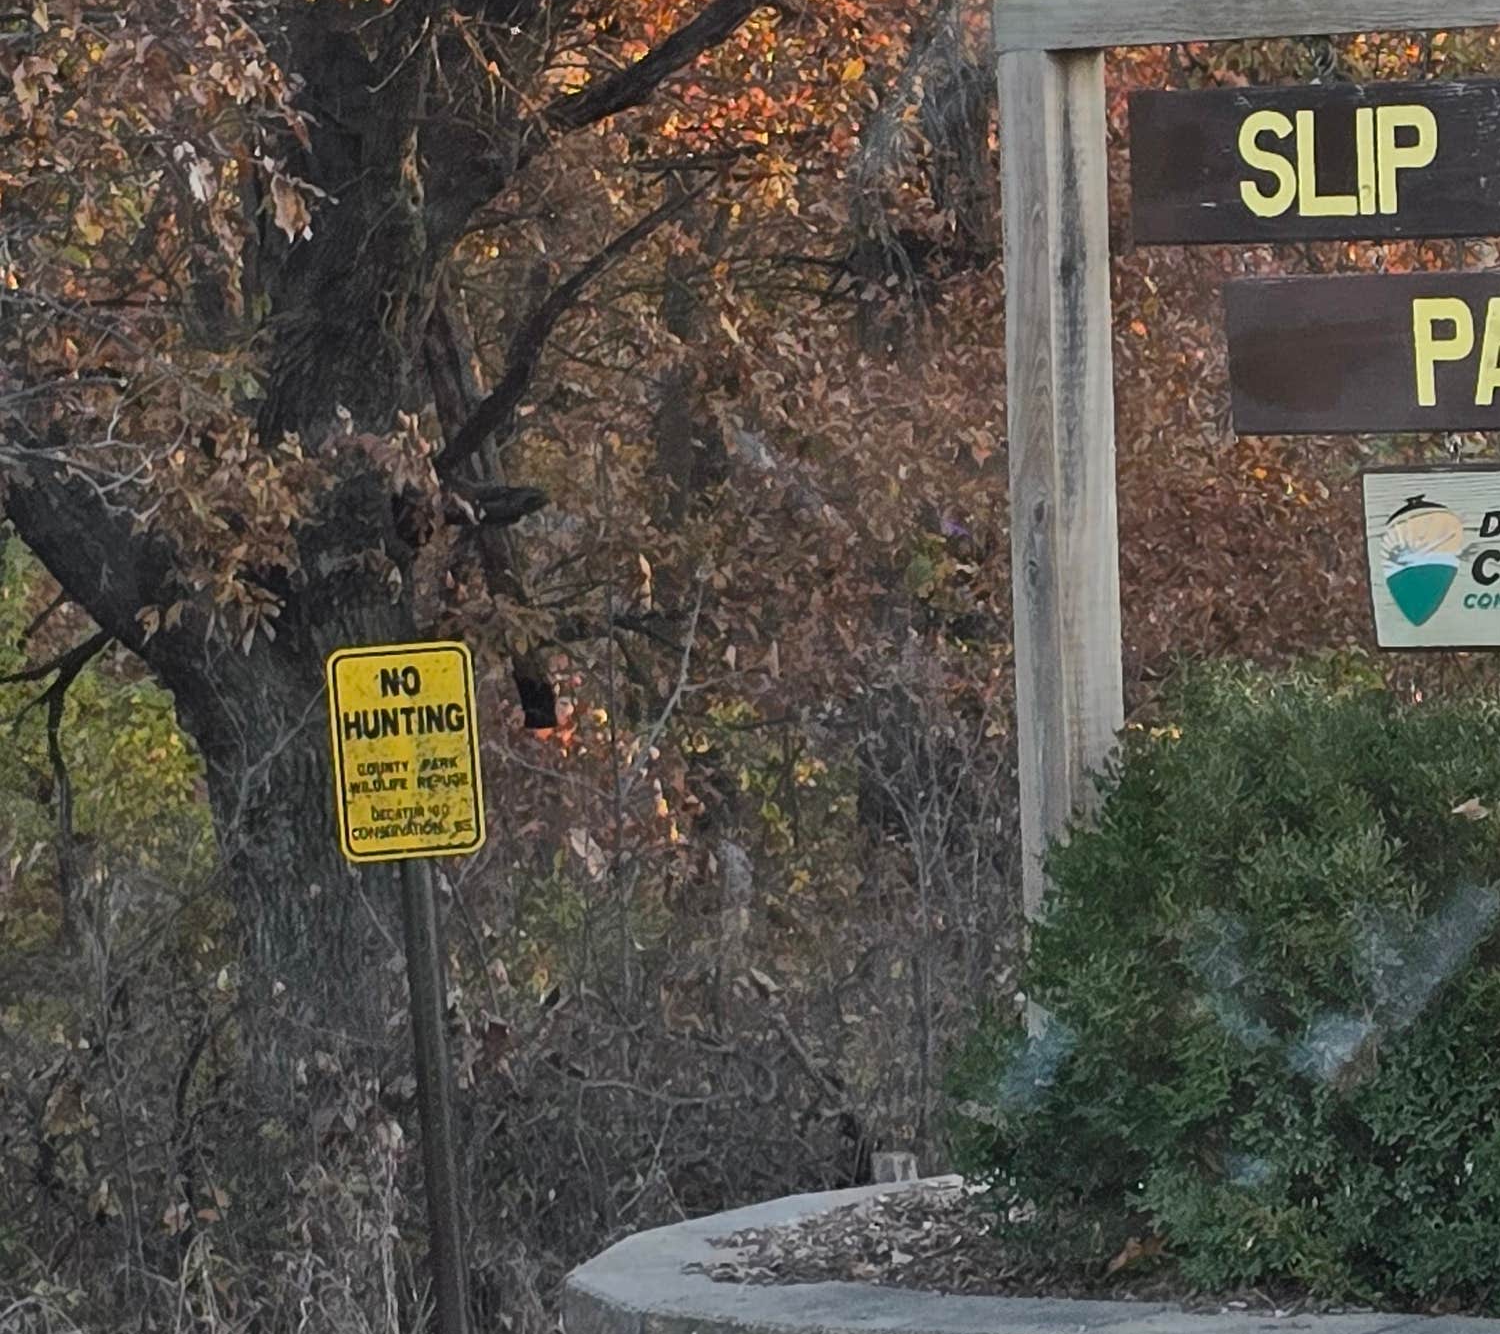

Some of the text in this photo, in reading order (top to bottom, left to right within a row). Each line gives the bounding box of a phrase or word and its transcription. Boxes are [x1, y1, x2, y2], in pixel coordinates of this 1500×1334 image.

[1237, 102, 1439, 218] SLIP
[380, 665, 421, 697] NO
[343, 703, 464, 740] HUNTING
[357, 760, 409, 776] COUNTY
